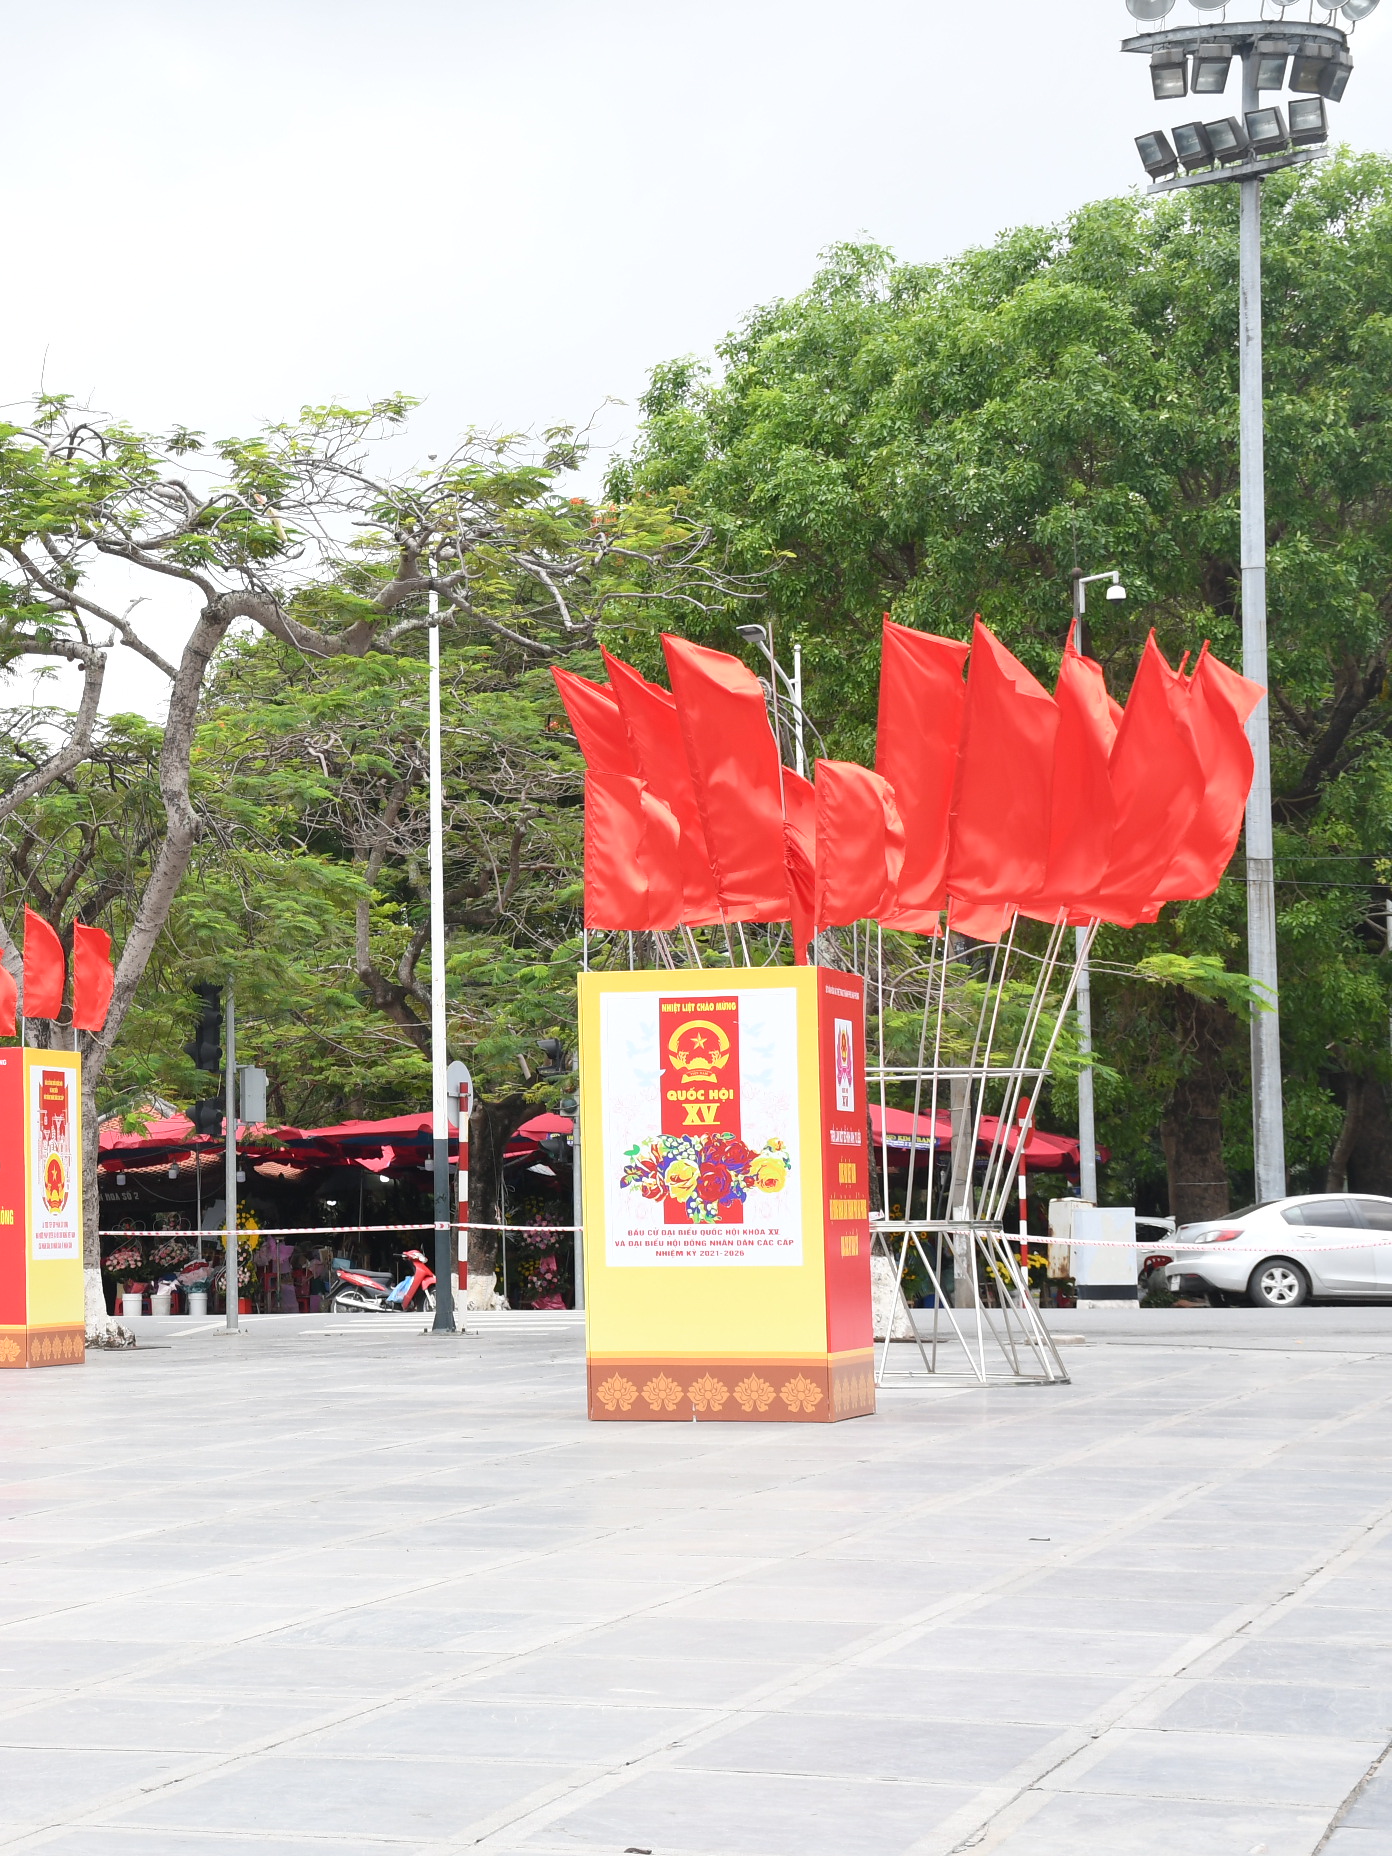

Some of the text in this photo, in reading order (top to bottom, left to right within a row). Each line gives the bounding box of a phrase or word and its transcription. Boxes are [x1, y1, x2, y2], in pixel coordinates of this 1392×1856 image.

[662, 1000, 736, 1014] NHIỆT LIỆT CHÀO MỪNG
[667, 1087, 734, 1102] QUỐC HỘI
[682, 1103, 720, 1125] XV
[134, 1192, 139, 1200] 2
